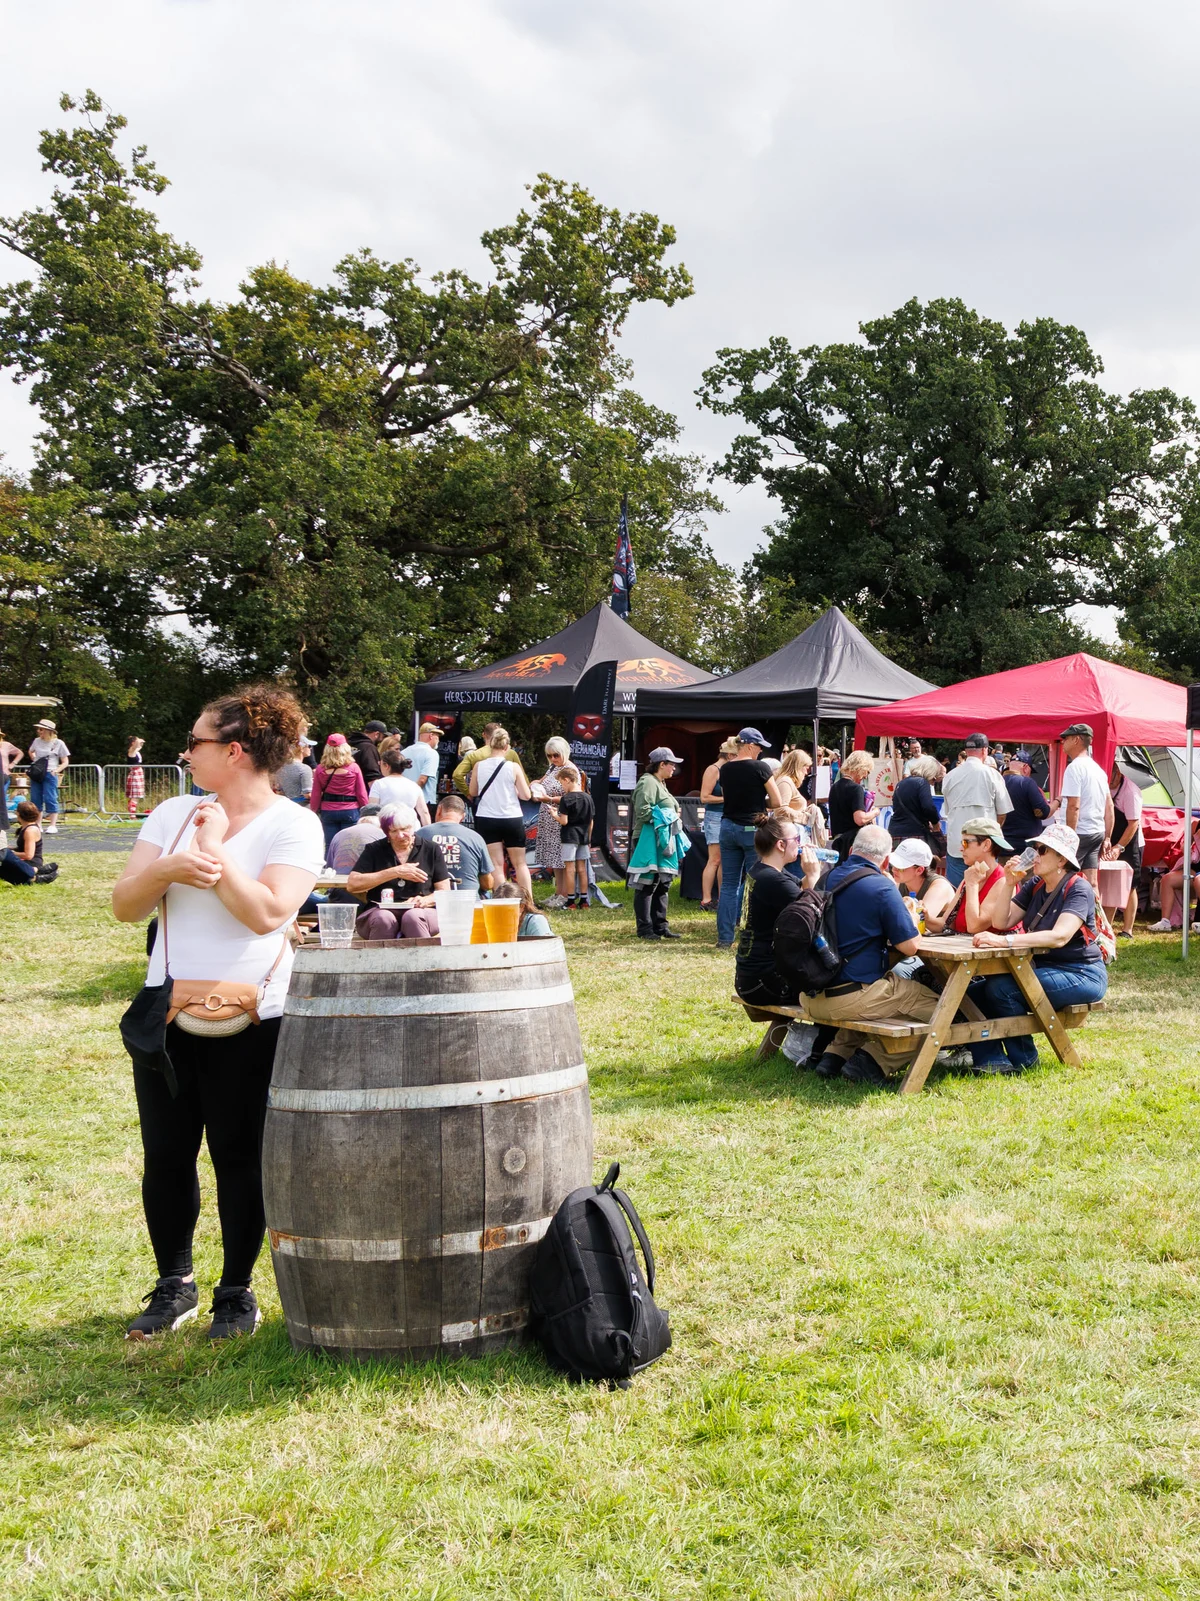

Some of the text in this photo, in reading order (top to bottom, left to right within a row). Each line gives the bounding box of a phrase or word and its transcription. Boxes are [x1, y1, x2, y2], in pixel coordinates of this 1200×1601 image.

[444, 692, 471, 704] HERE'S
[472, 691, 484, 702] TO
[486, 691, 502, 703] THE
[432, 834, 458, 845] OLD
